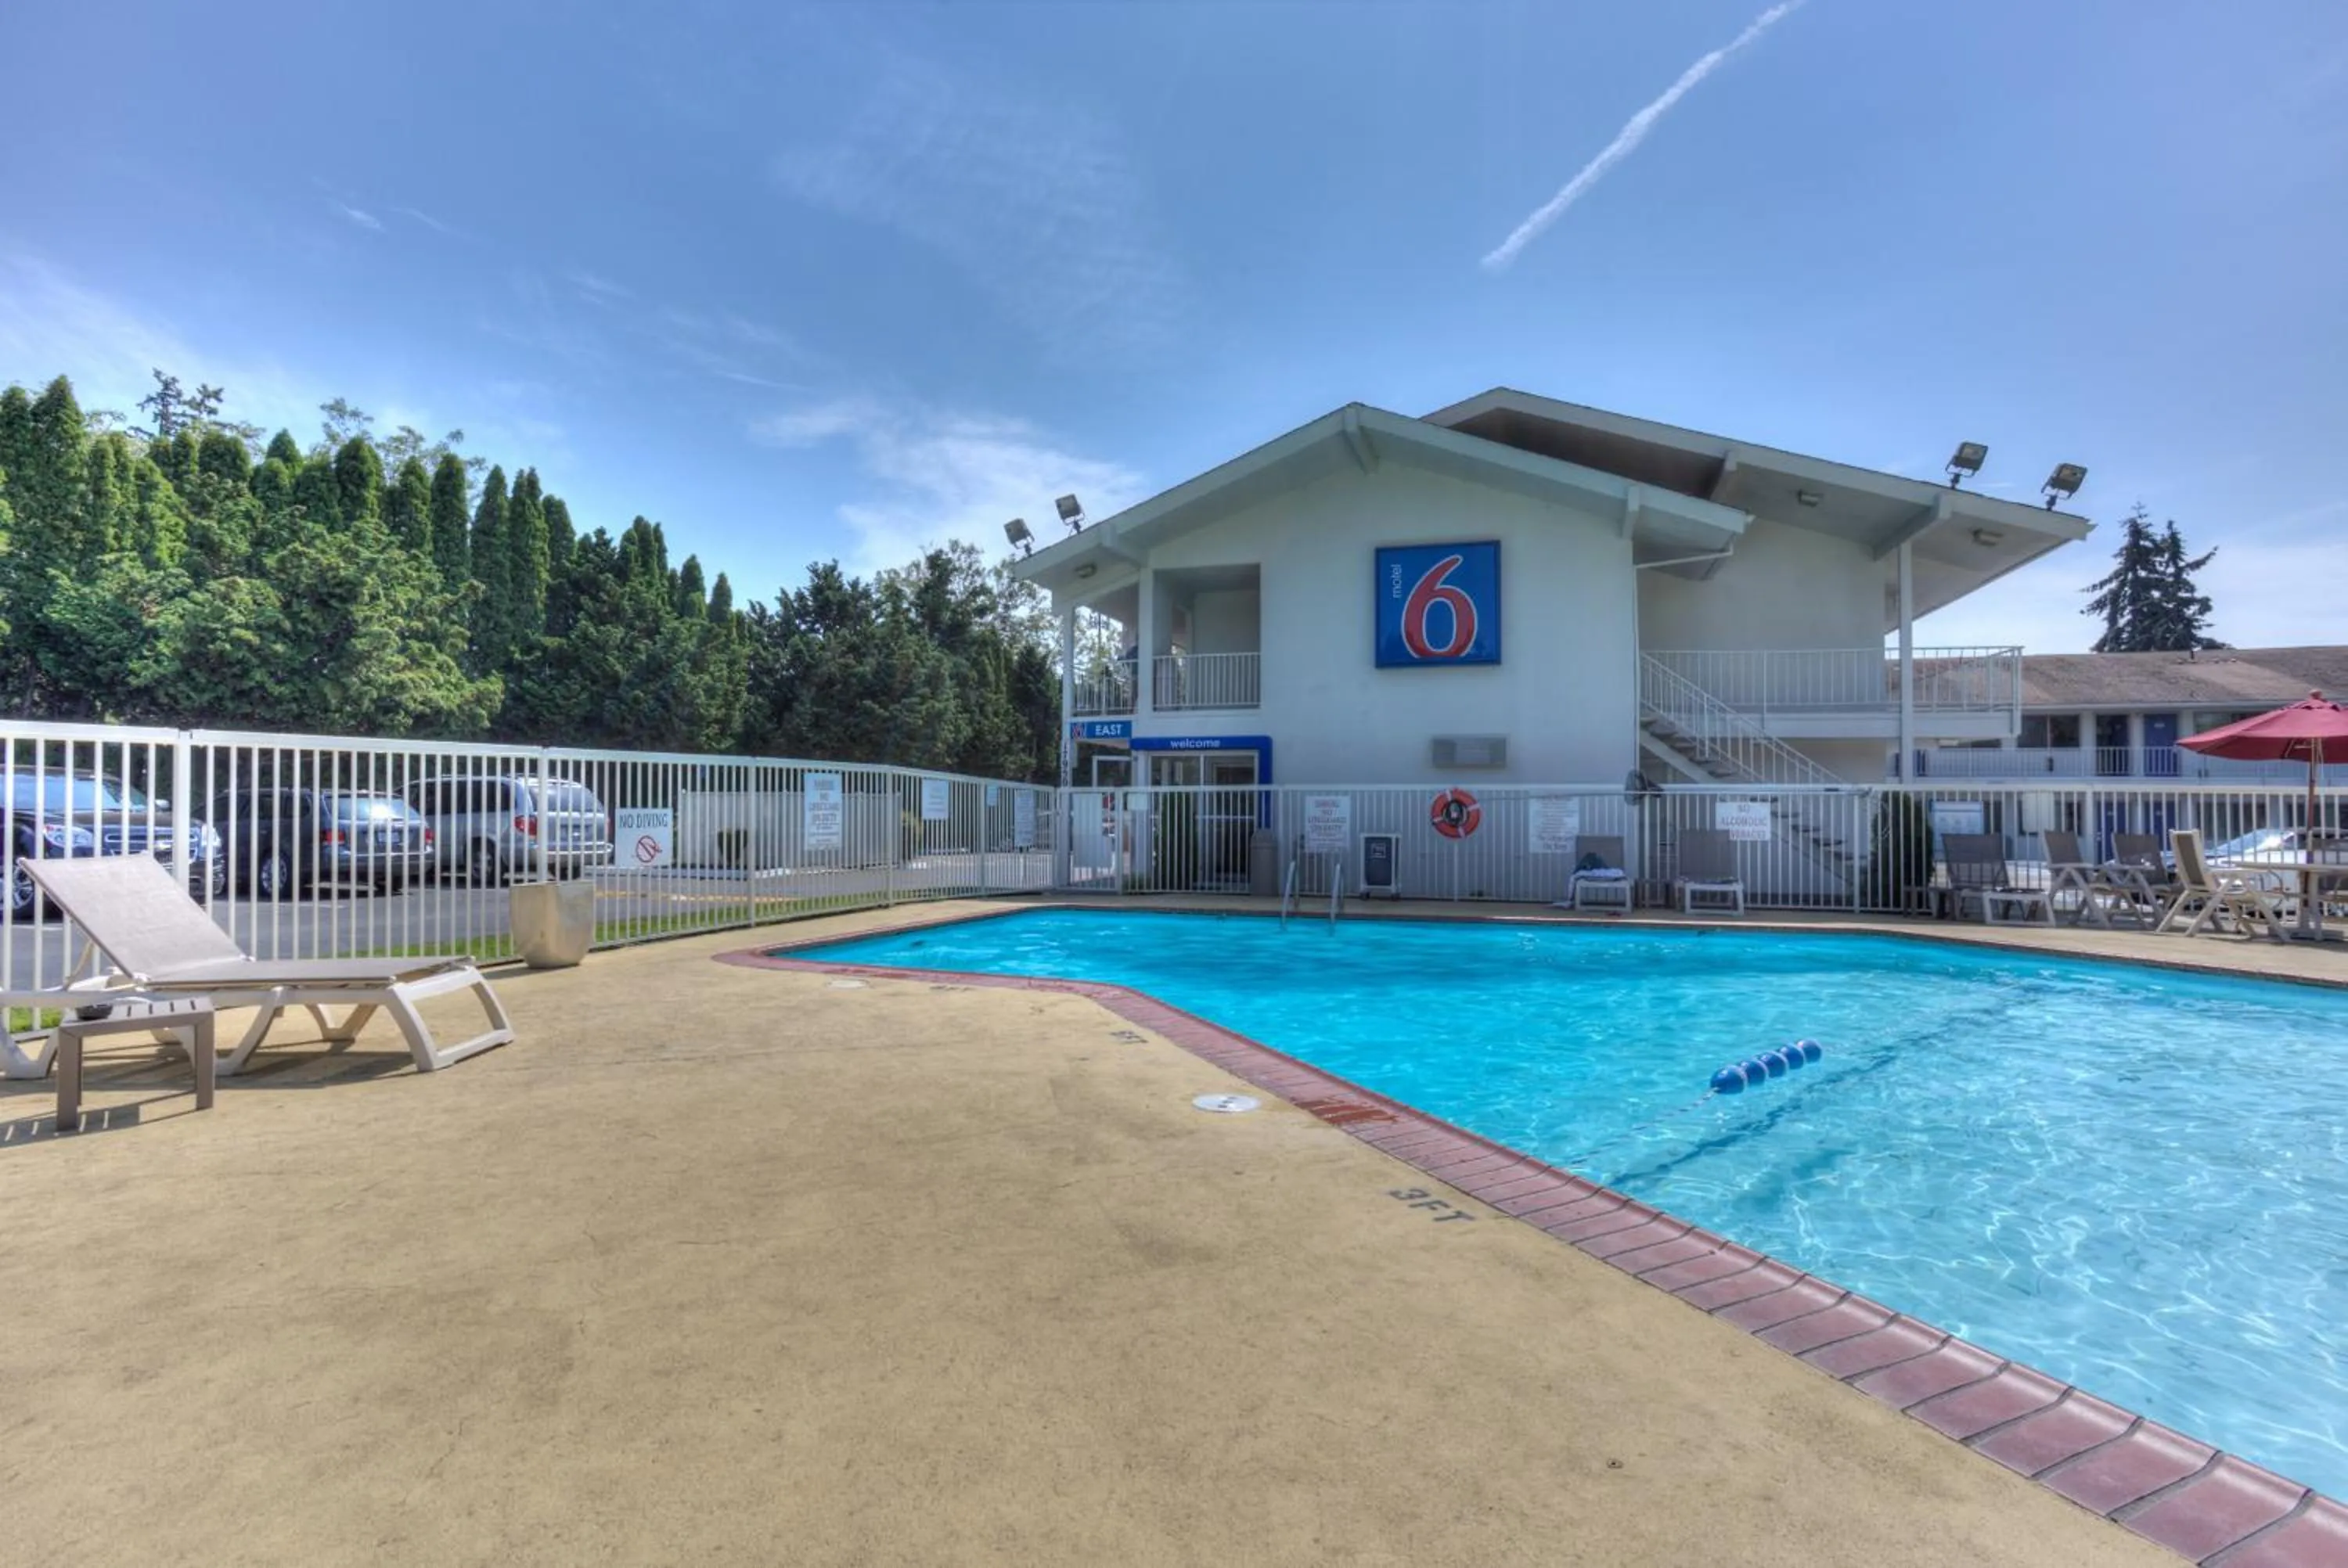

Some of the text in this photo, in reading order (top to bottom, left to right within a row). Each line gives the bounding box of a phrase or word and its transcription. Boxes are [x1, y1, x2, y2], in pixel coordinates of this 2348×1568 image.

[1390, 563, 1403, 599] motel
[1400, 554, 1478, 659] 6
[1096, 723, 1122, 735] EAST
[1170, 738, 1220, 749] welcome
[619, 813, 668, 828] NO DIVING
[1389, 1188, 1475, 1221] 3FT
